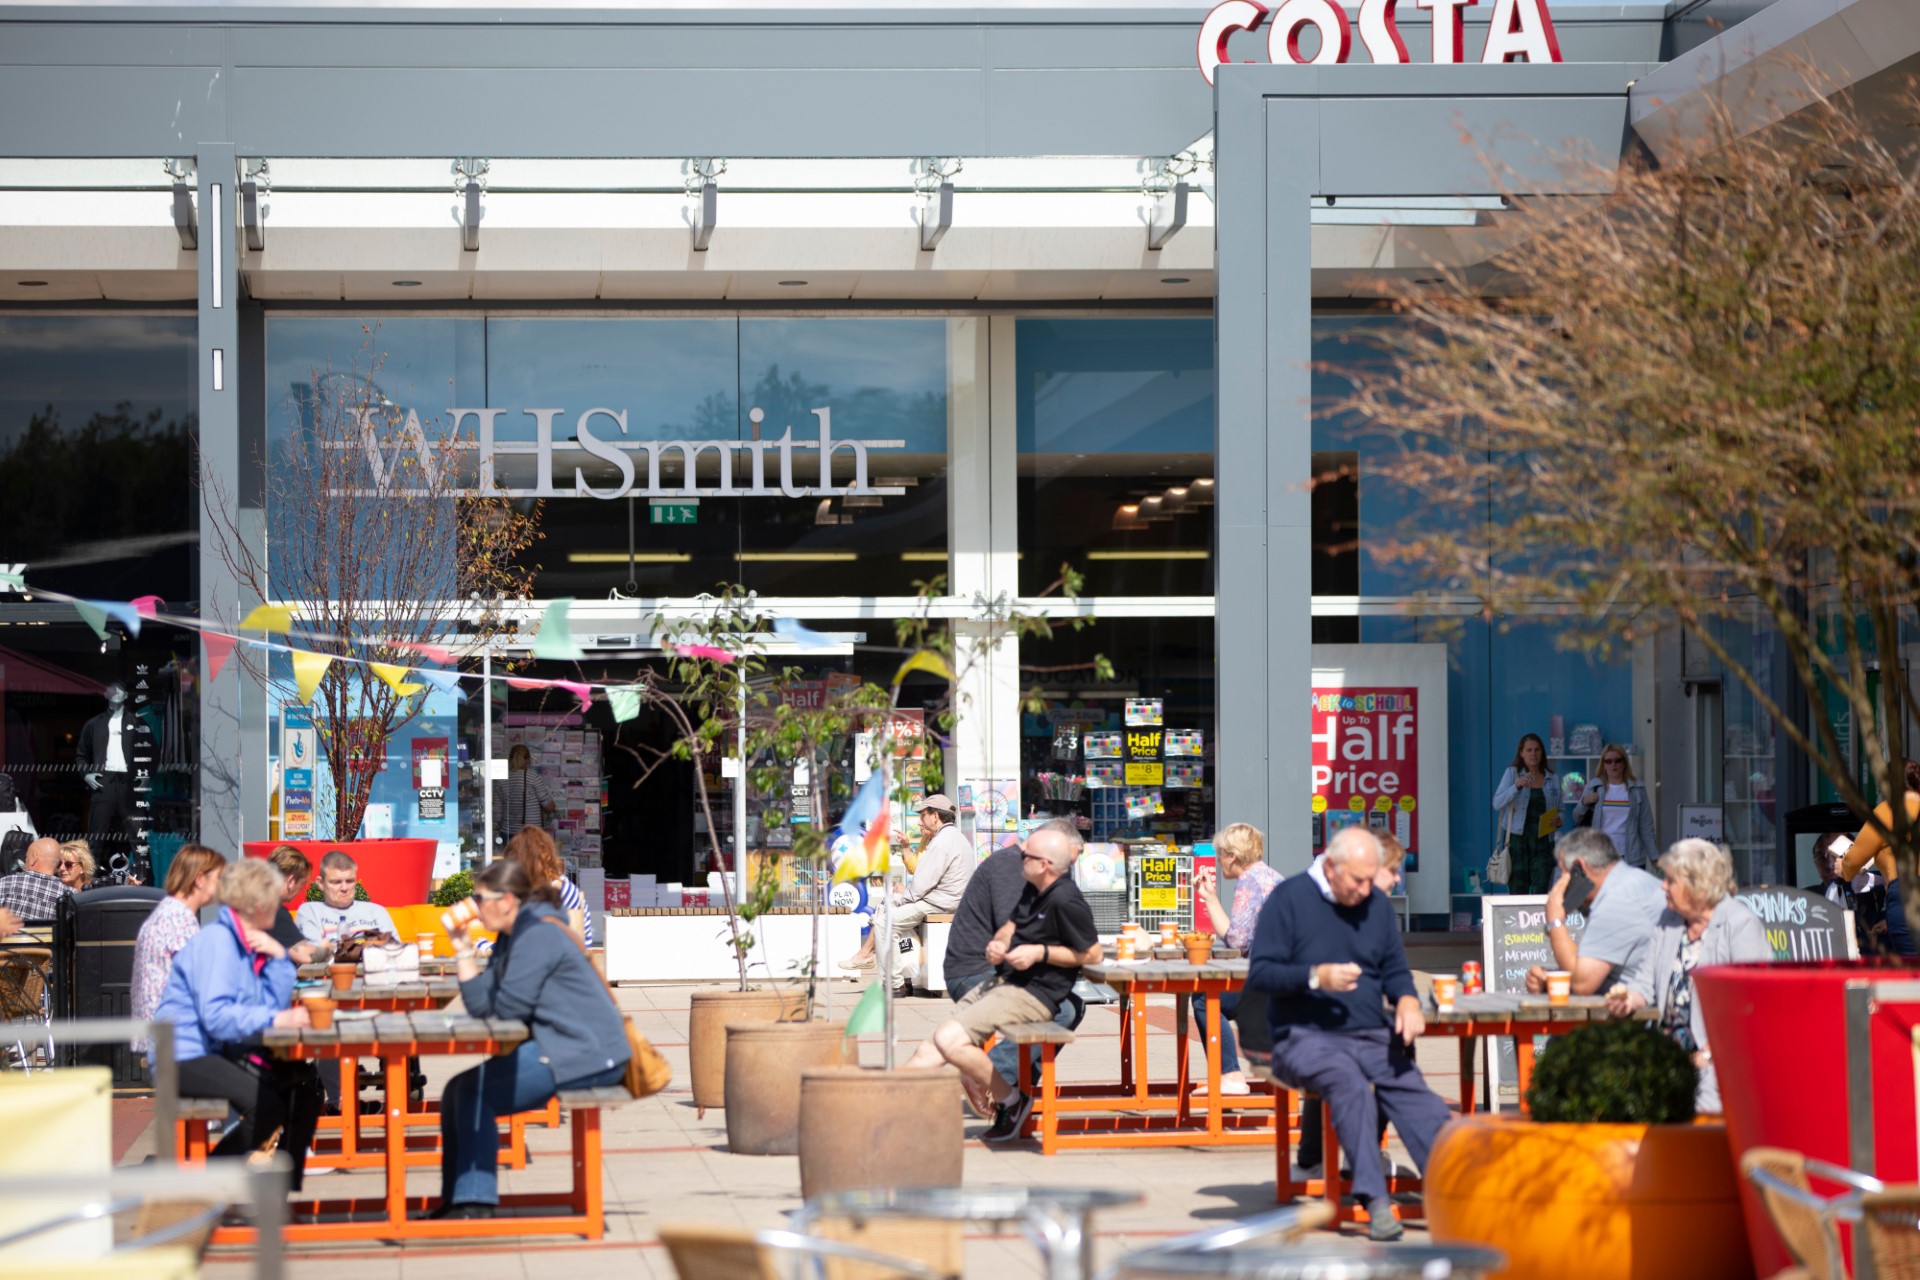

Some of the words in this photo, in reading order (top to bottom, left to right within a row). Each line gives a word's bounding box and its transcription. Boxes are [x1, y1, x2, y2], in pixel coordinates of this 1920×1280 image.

[1197, 0, 1563, 87] COSTA
[345, 406, 877, 499] WHSmith
[782, 690, 820, 707] Half
[1342, 716, 1356, 725] Up
[1358, 715, 1371, 725] To
[1053, 737, 1063, 749] 4
[1068, 737, 1078, 750] 3
[1127, 732, 1162, 747] Half
[1312, 714, 1414, 761] Half
[1131, 746, 1158, 756] Price
[1312, 765, 1399, 794] Price
[419, 790, 444, 798] CCTV
[791, 787, 811, 796] CCT
[1142, 858, 1176, 872] Half
[1145, 871, 1171, 881] Price
[834, 898, 854, 906] NOW
[1766, 929, 1788, 951] NO
[1505, 948, 1548, 962] MEMPHIS
